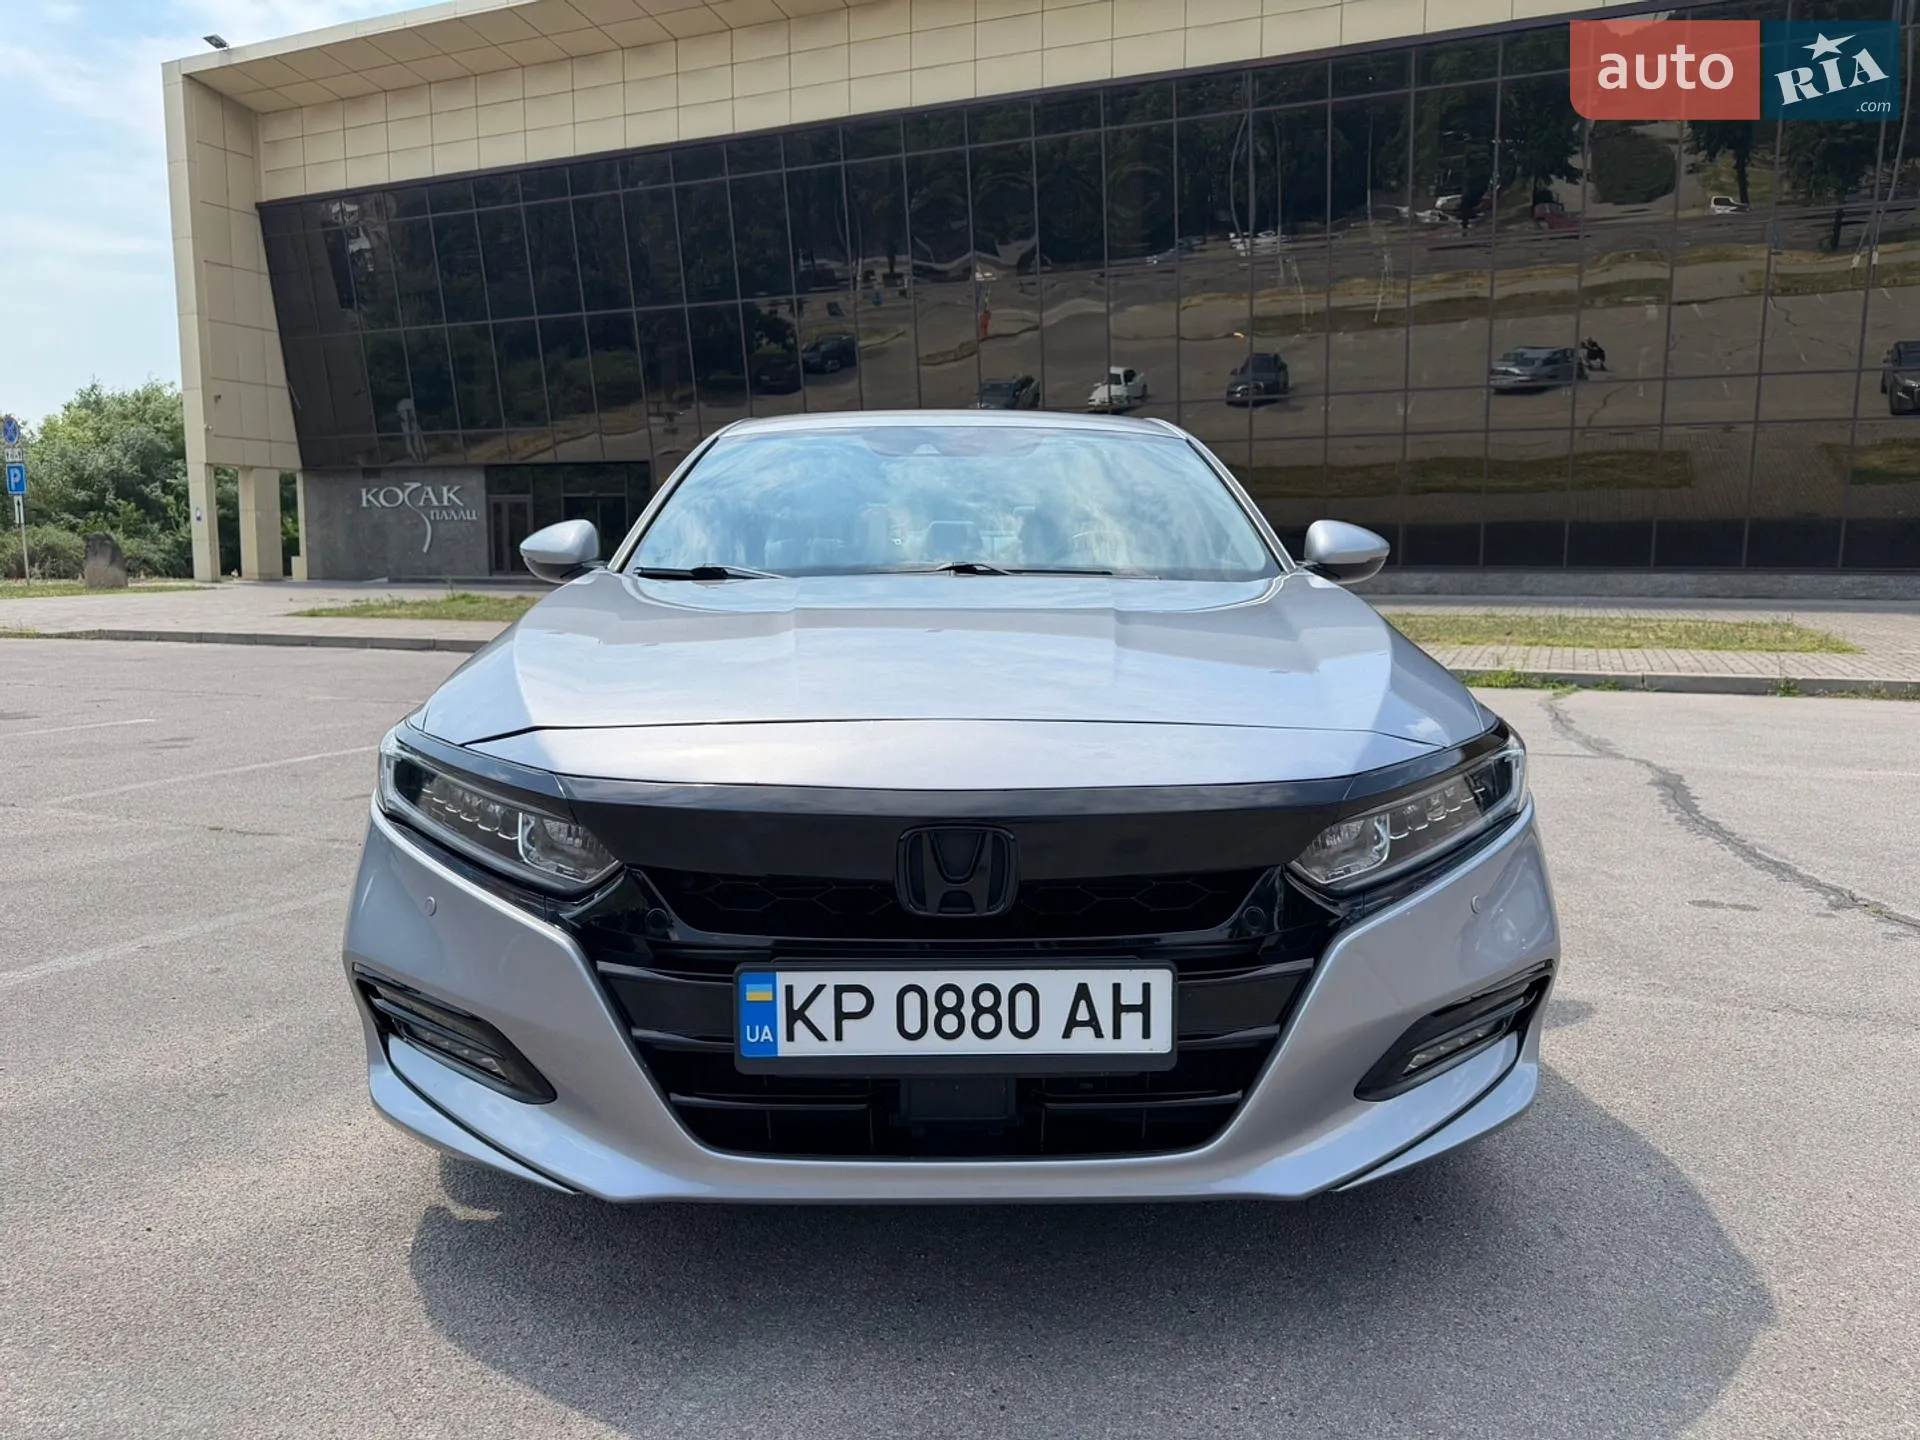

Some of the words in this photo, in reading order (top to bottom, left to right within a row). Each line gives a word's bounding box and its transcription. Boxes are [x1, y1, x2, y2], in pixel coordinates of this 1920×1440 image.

[784, 984, 875, 1042] KP
[896, 982, 1041, 1041] 0880
[1061, 982, 1152, 1040] AH
[746, 1024, 774, 1043] UA
